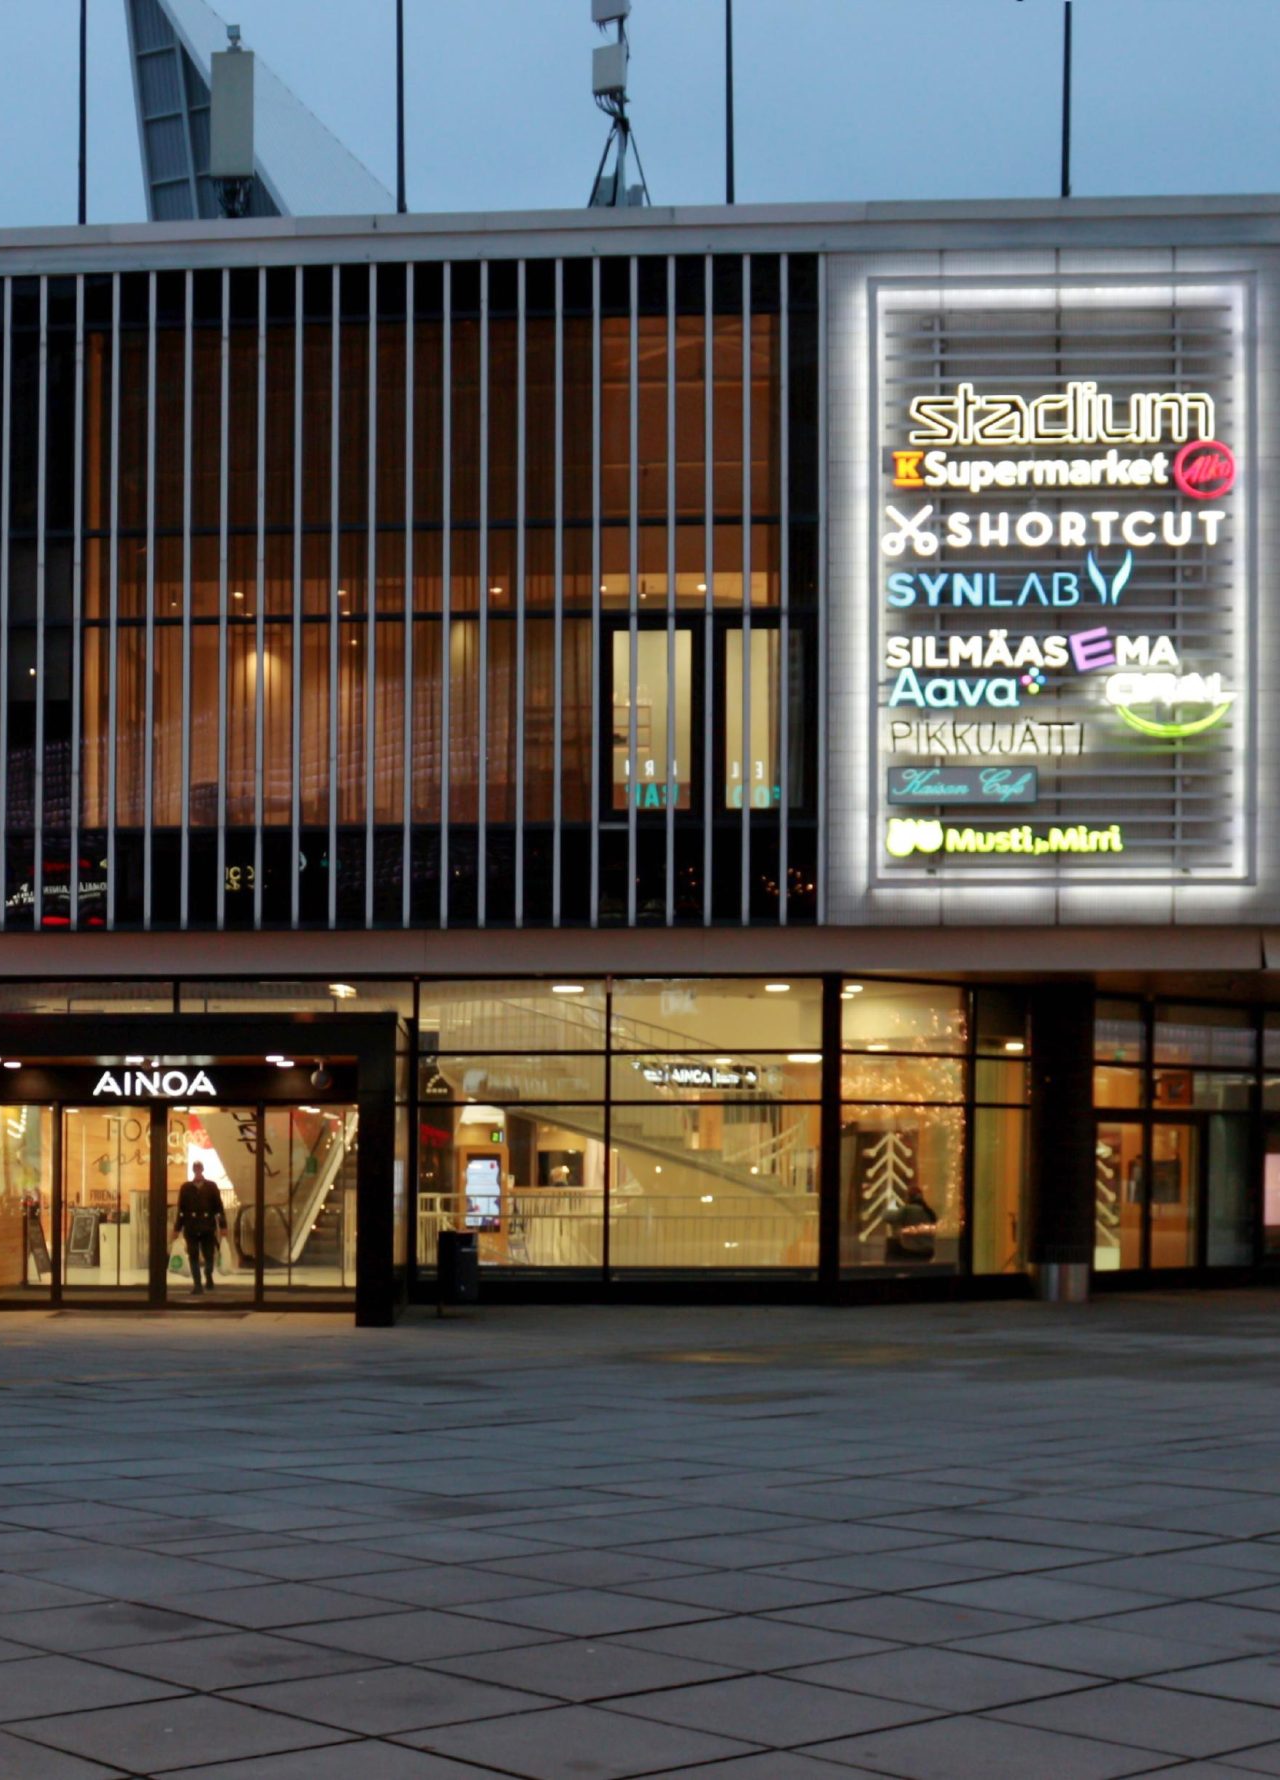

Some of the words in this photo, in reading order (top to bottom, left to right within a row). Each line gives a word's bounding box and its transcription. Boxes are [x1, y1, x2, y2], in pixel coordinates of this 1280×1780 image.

[909, 381, 1215, 446] stadium
[924, 449, 1169, 492] Supermarket
[945, 510, 1226, 548] SHORTCUT
[886, 571, 1080, 608] SYNLAB
[886, 627, 1178, 672] SILMÄASEMA
[887, 667, 1020, 708] Aava
[890, 716, 1086, 755] PIKKUJÄTTI
[945, 824, 1033, 853] Musti
[1048, 824, 1123, 852] Mirri
[92, 1069, 218, 1097] AINOA
